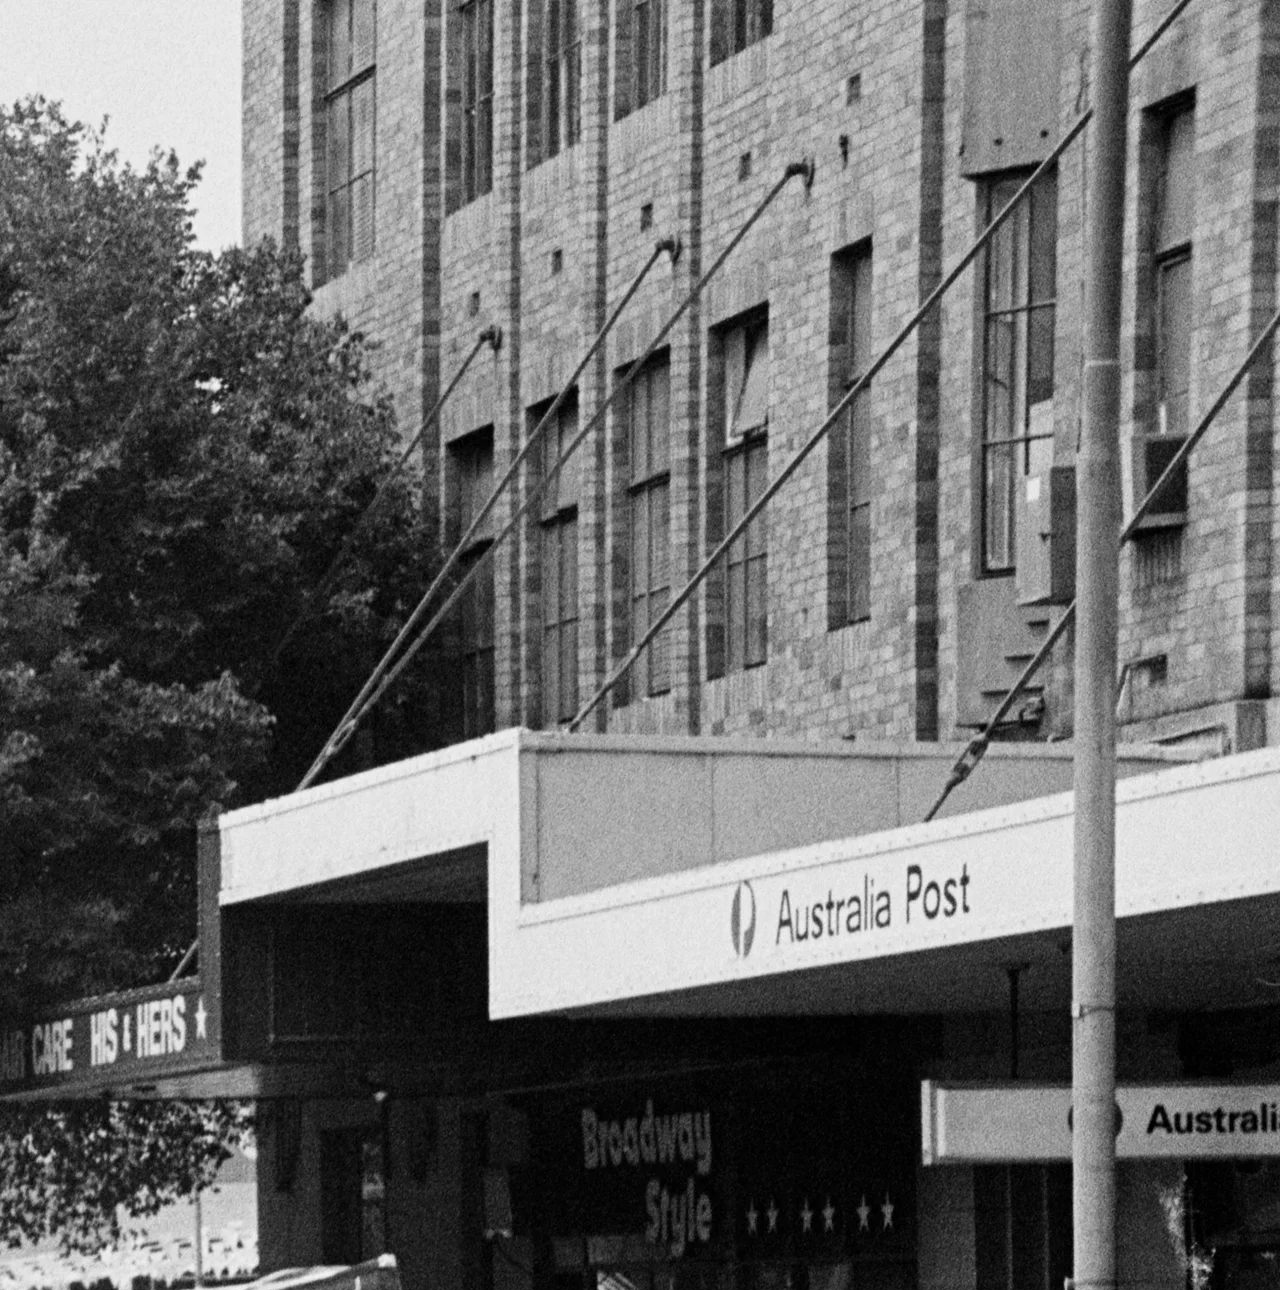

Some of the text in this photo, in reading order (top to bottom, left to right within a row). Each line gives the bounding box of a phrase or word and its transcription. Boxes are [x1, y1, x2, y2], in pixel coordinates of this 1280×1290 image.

[776, 863, 970, 945] Australia Post
[32, 1018, 73, 1076] CARE
[90, 1008, 117, 1067] HIS
[137, 995, 186, 1059] HERS
[582, 1100, 712, 1176] Broadway
[1146, 1101, 1280, 1135] Australi
[646, 1178, 712, 1258] Style
